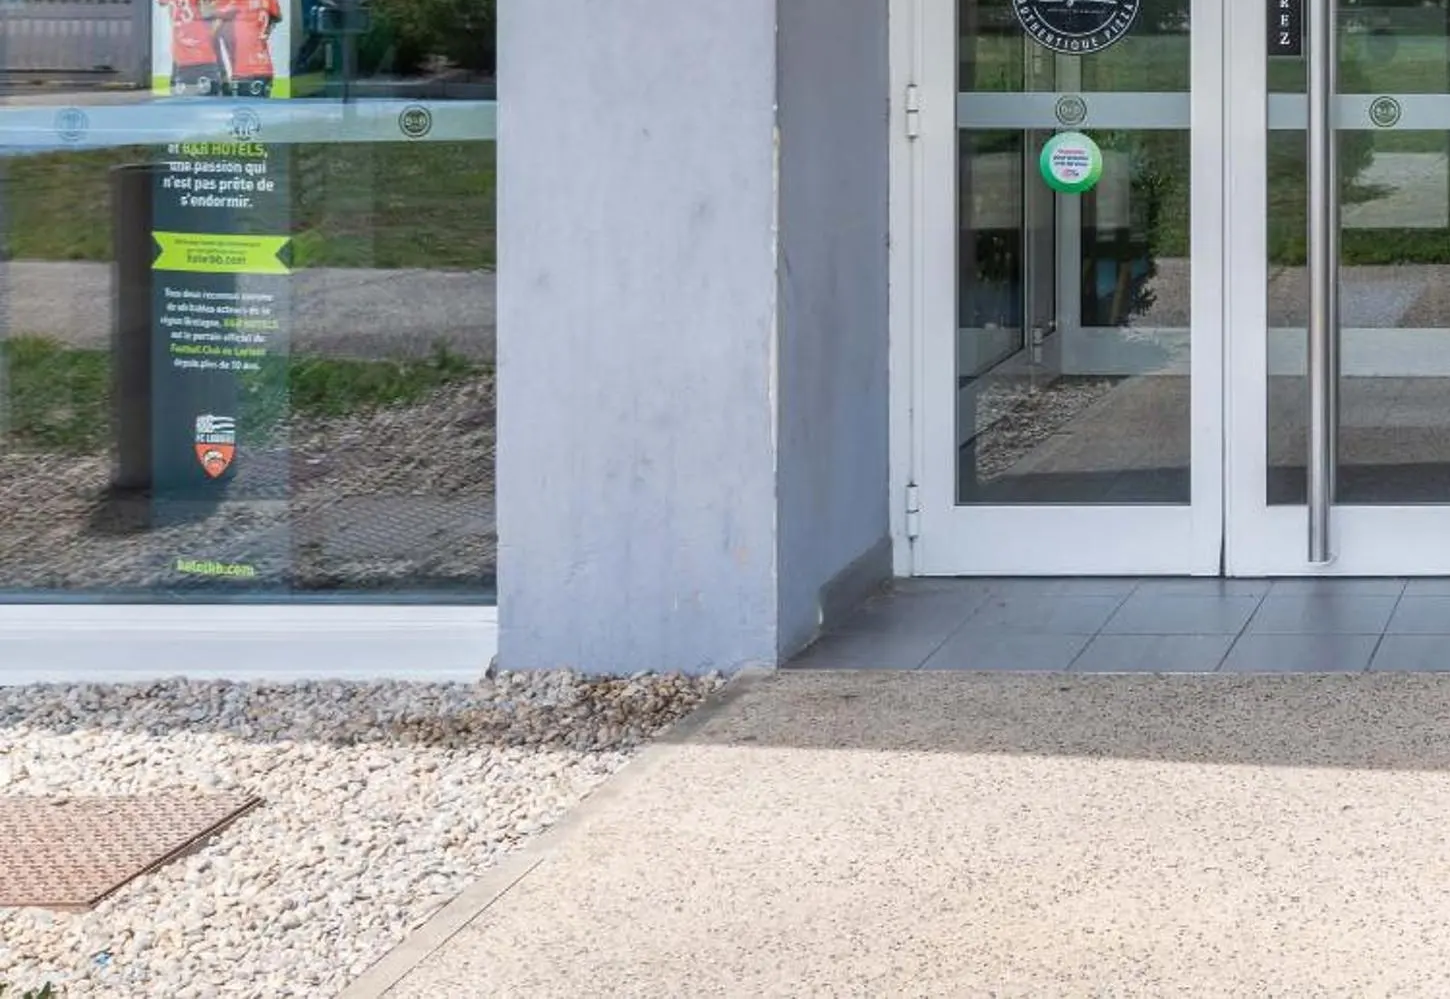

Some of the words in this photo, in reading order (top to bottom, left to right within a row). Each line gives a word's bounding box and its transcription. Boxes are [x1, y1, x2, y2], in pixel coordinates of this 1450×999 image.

[1103, 3, 1134, 39] PIZZA
[194, 160, 242, 174] passion
[244, 161, 266, 176] qui
[163, 176, 192, 189] n'est
[194, 178, 217, 192] pas
[256, 178, 276, 192] de
[180, 193, 254, 208] s'endormir.
